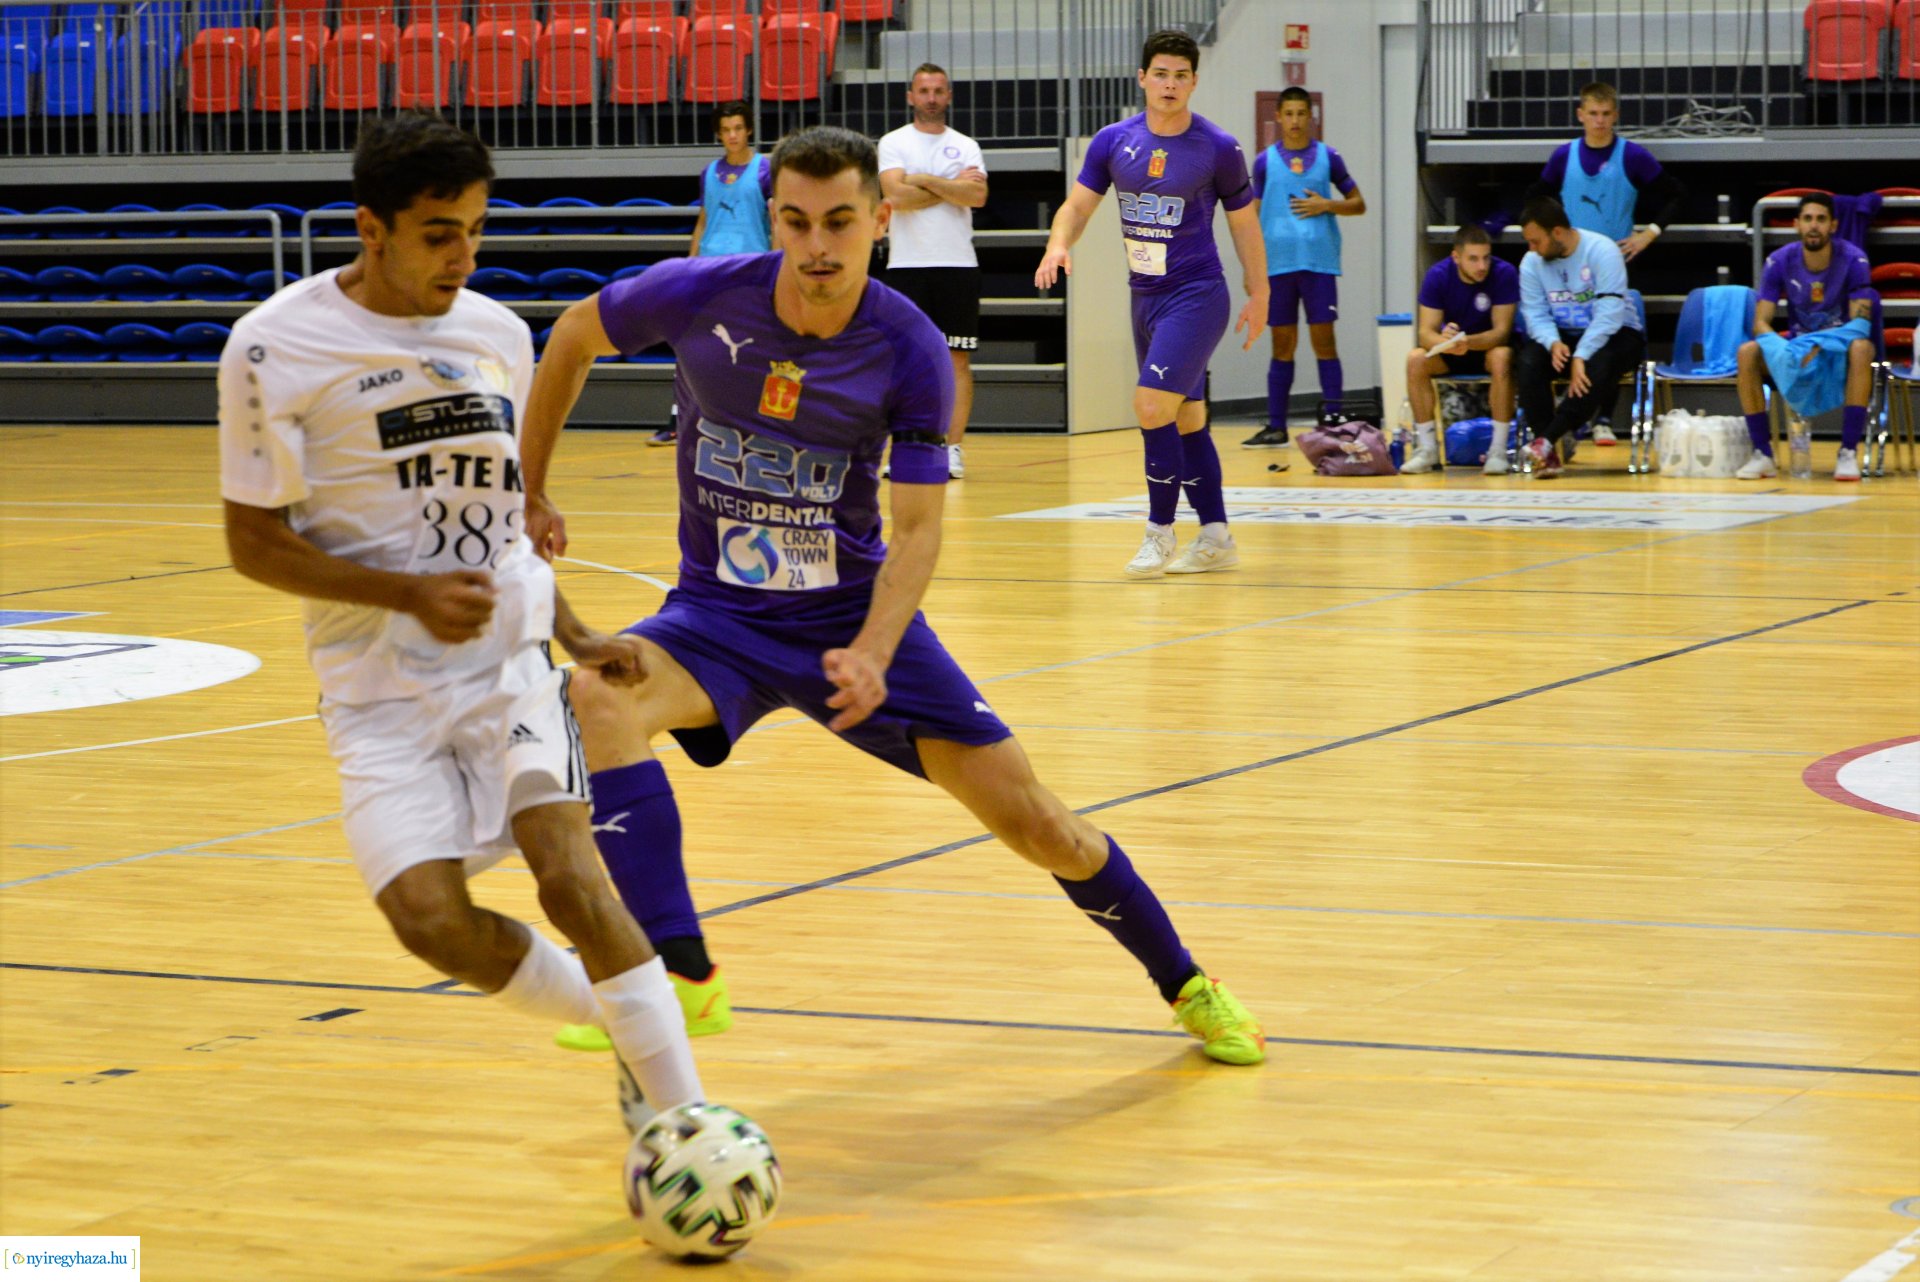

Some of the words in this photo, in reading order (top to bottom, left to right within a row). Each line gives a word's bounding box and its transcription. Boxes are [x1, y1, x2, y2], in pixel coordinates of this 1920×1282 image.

[1118, 192, 1185, 226] 220
[358, 369, 404, 392] JAKO
[395, 452, 493, 490] TA-TE
[694, 417, 851, 503] 220
[801, 485, 836, 499] VOLT
[698, 485, 836, 526] INTERDENTAL
[782, 529, 831, 547] CRAZY
[784, 547, 828, 565] TOWN
[788, 568, 805, 588] 24
